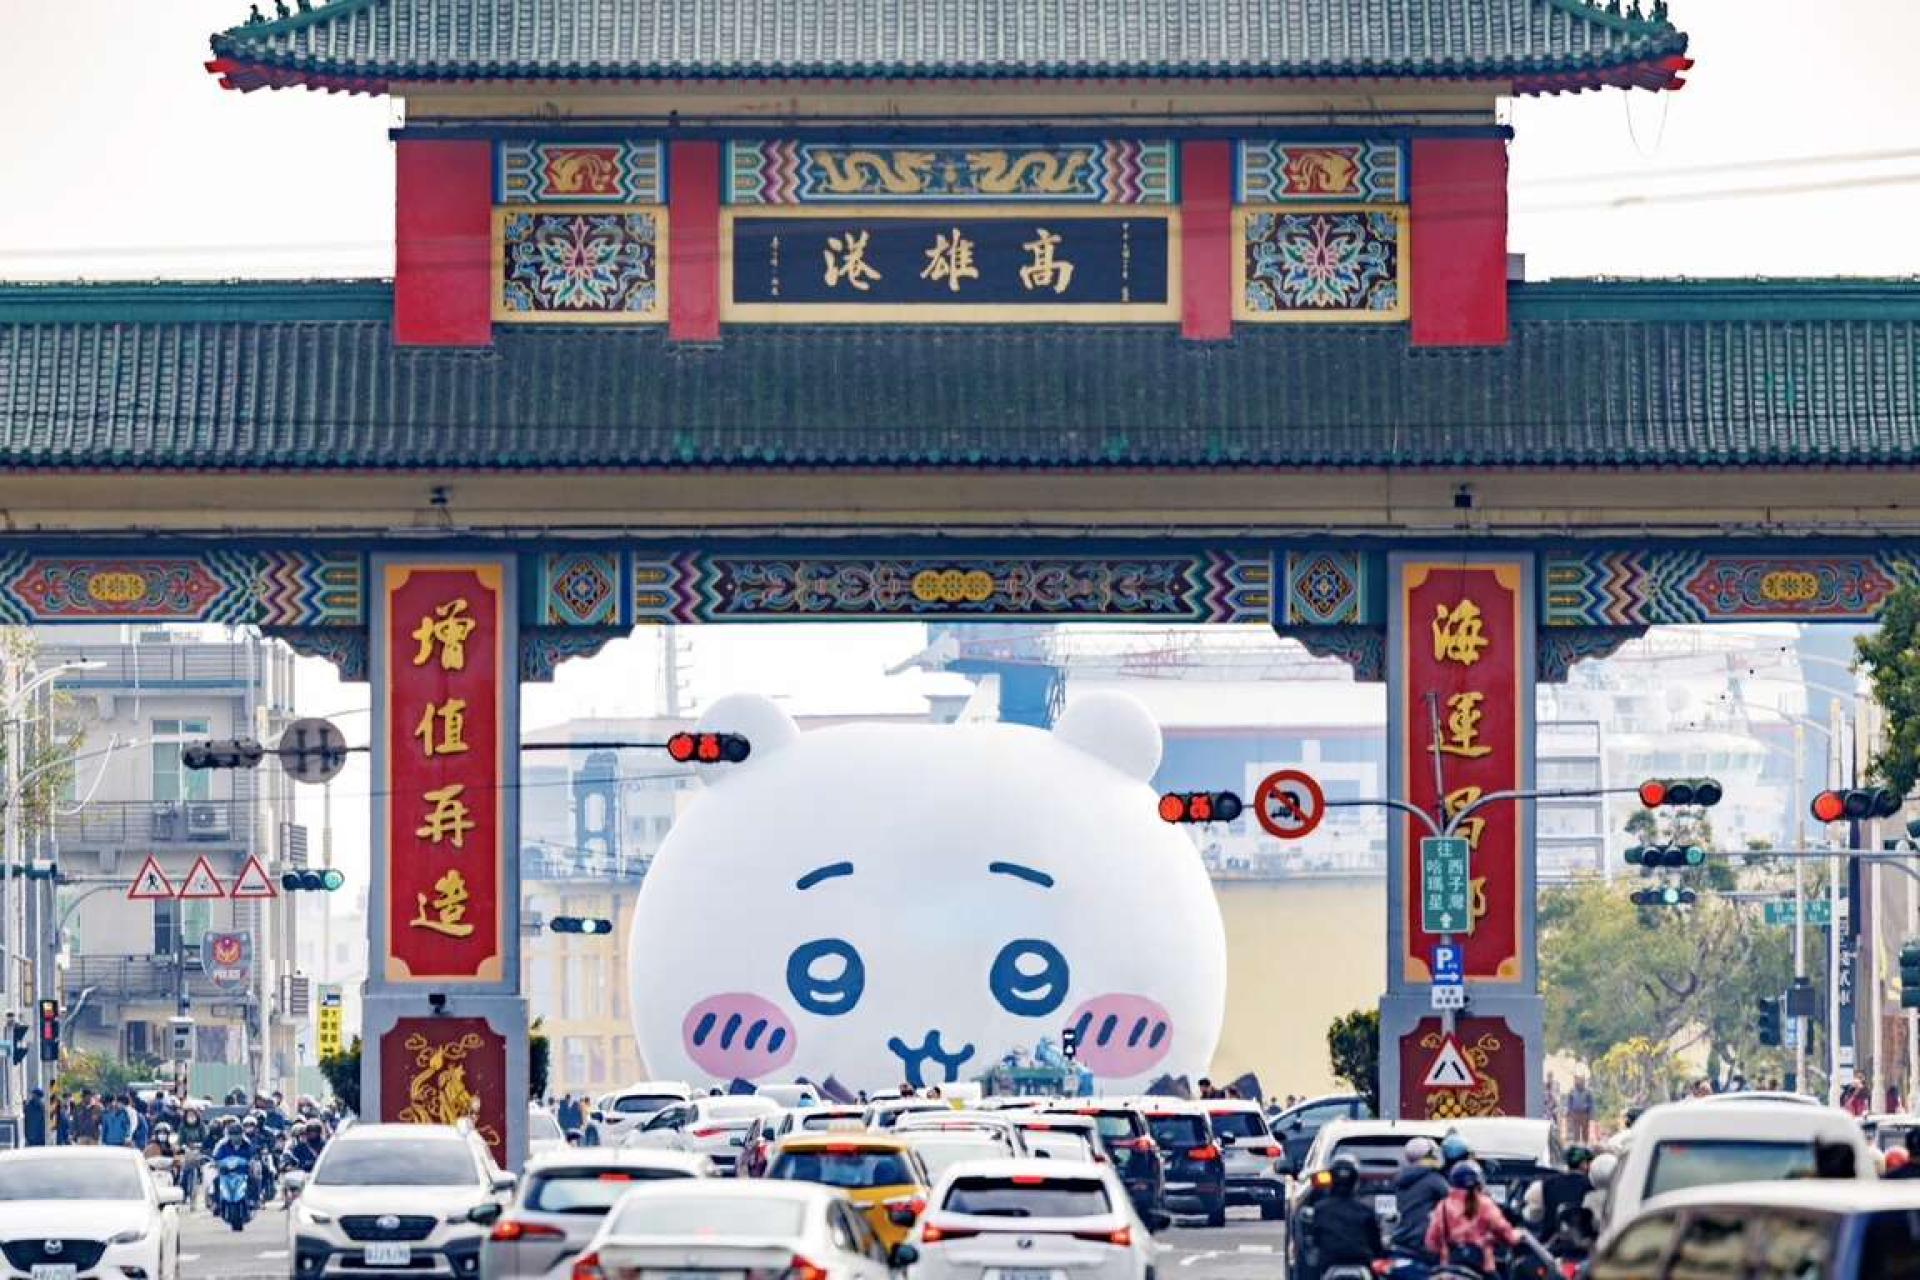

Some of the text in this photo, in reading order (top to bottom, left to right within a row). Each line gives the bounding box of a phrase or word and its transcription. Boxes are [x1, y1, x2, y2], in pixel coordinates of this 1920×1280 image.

[410, 598, 476, 938] 增值再造
[1436, 947, 1454, 970] P
